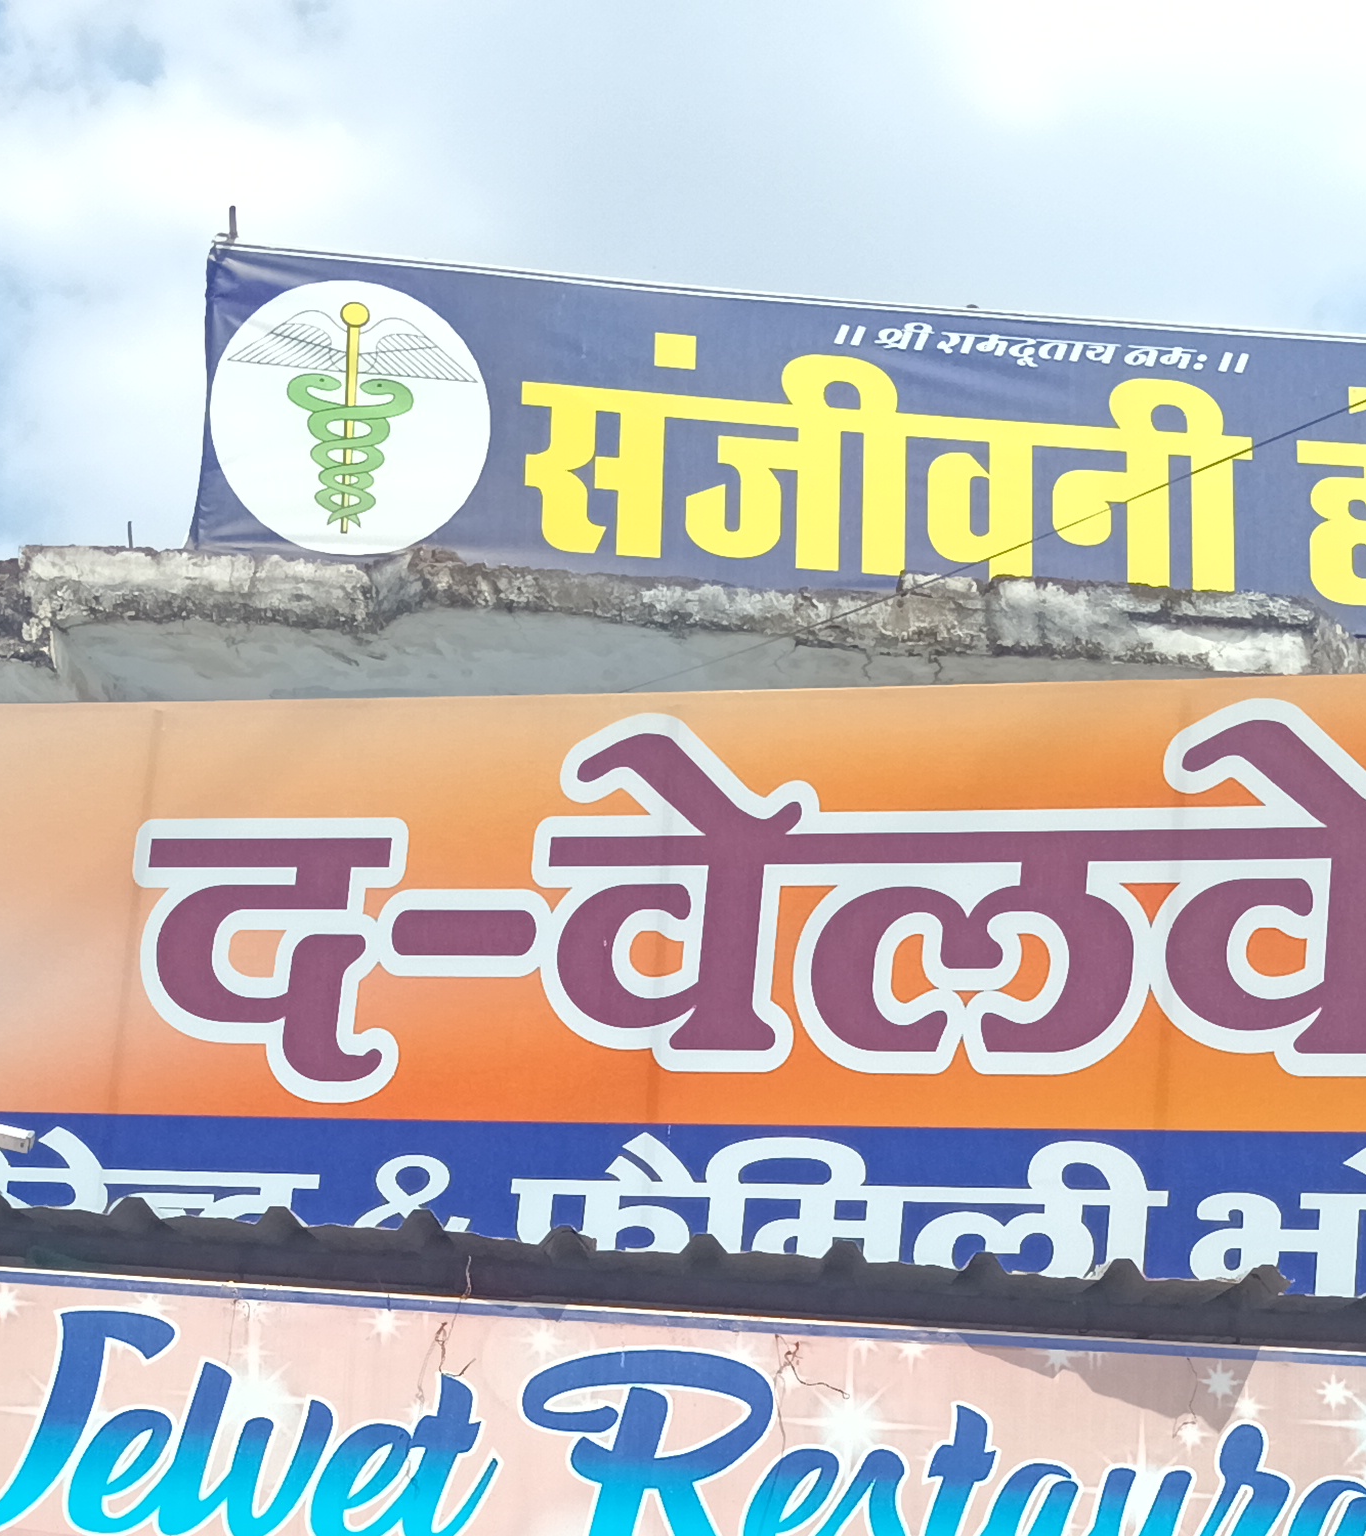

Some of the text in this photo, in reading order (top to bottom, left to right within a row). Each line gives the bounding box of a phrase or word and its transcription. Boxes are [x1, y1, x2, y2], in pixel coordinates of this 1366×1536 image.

[873, 322, 935, 351] श्री
[937, 330, 1120, 368] रामदूताय
[521, 333, 1253, 592] संजीवनी
